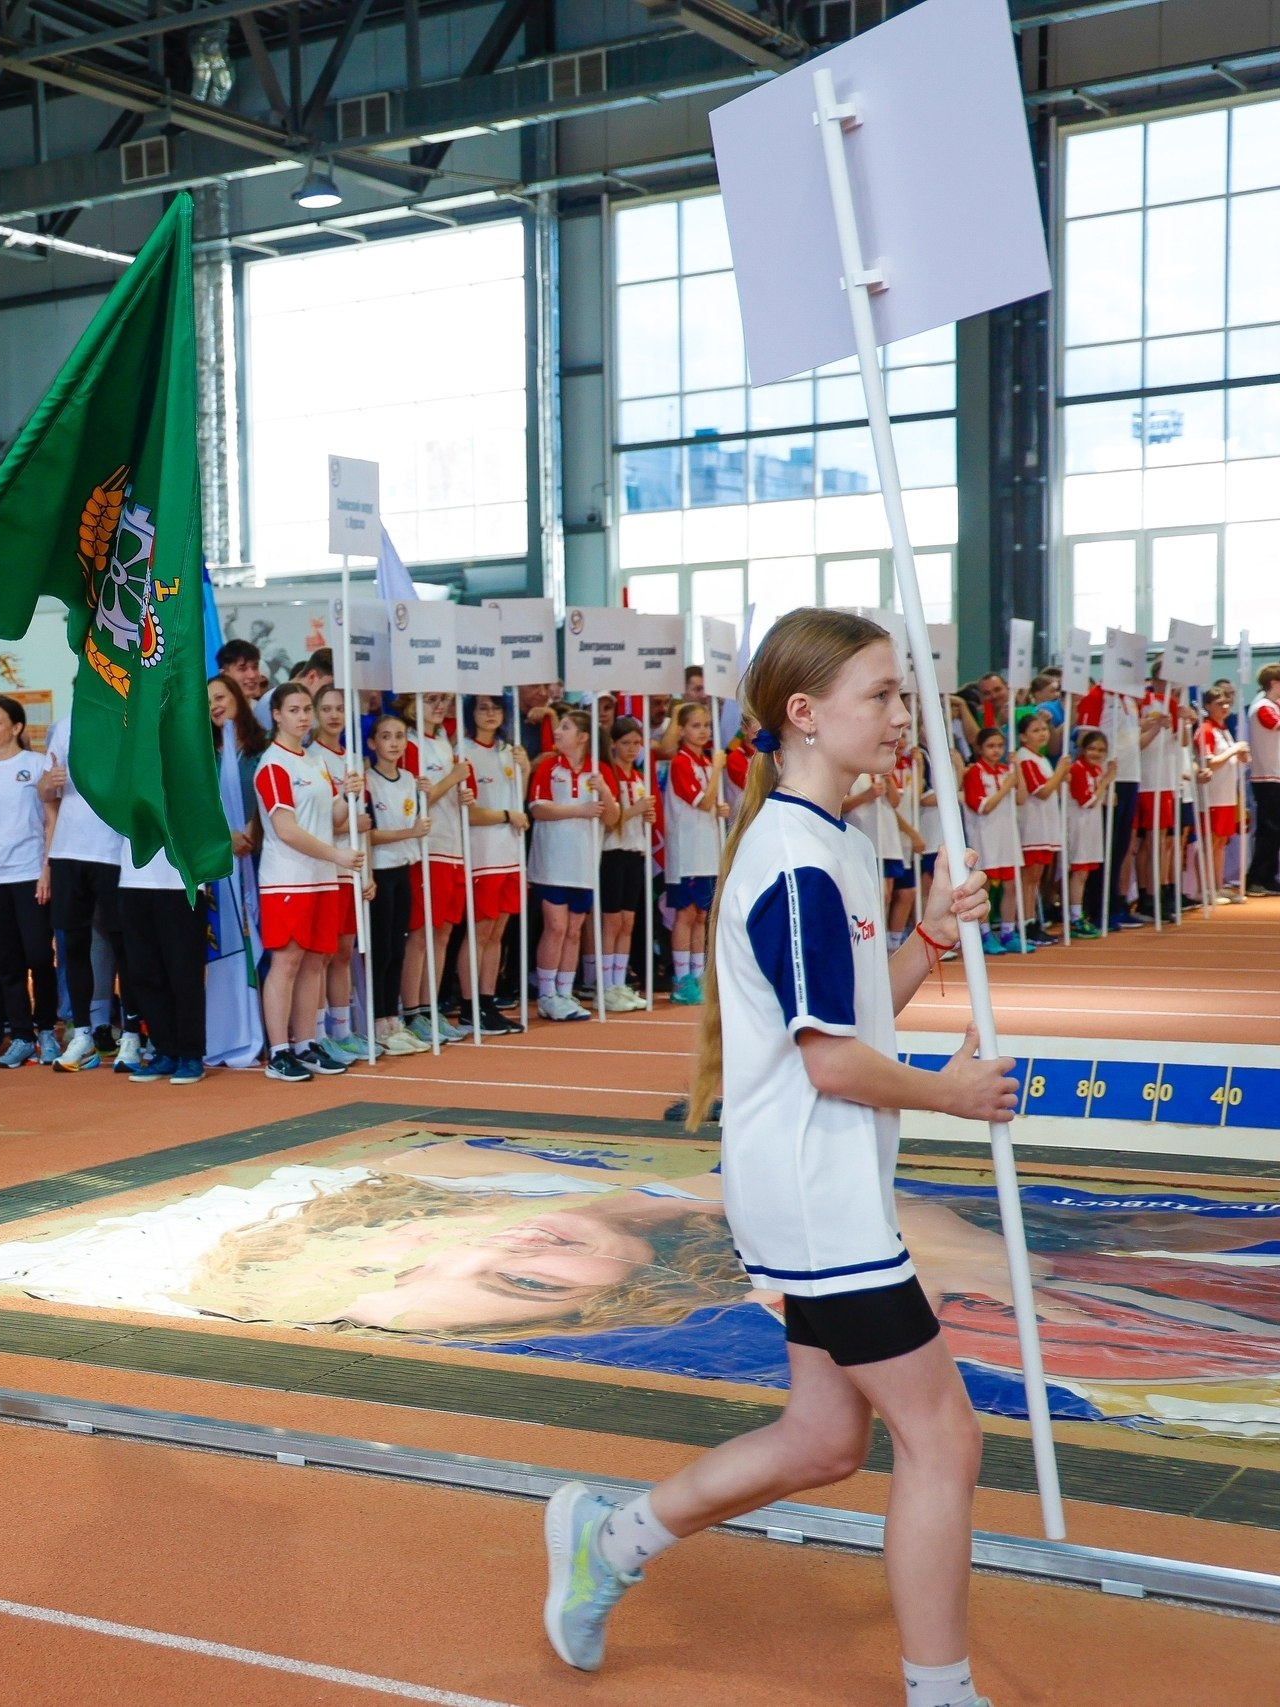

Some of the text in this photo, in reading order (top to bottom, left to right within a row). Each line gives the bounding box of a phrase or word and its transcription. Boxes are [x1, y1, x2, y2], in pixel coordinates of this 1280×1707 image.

[1076, 1078, 1106, 1098] 80
[1142, 1082, 1173, 1102] 60
[1211, 1087, 1243, 1105] 40
